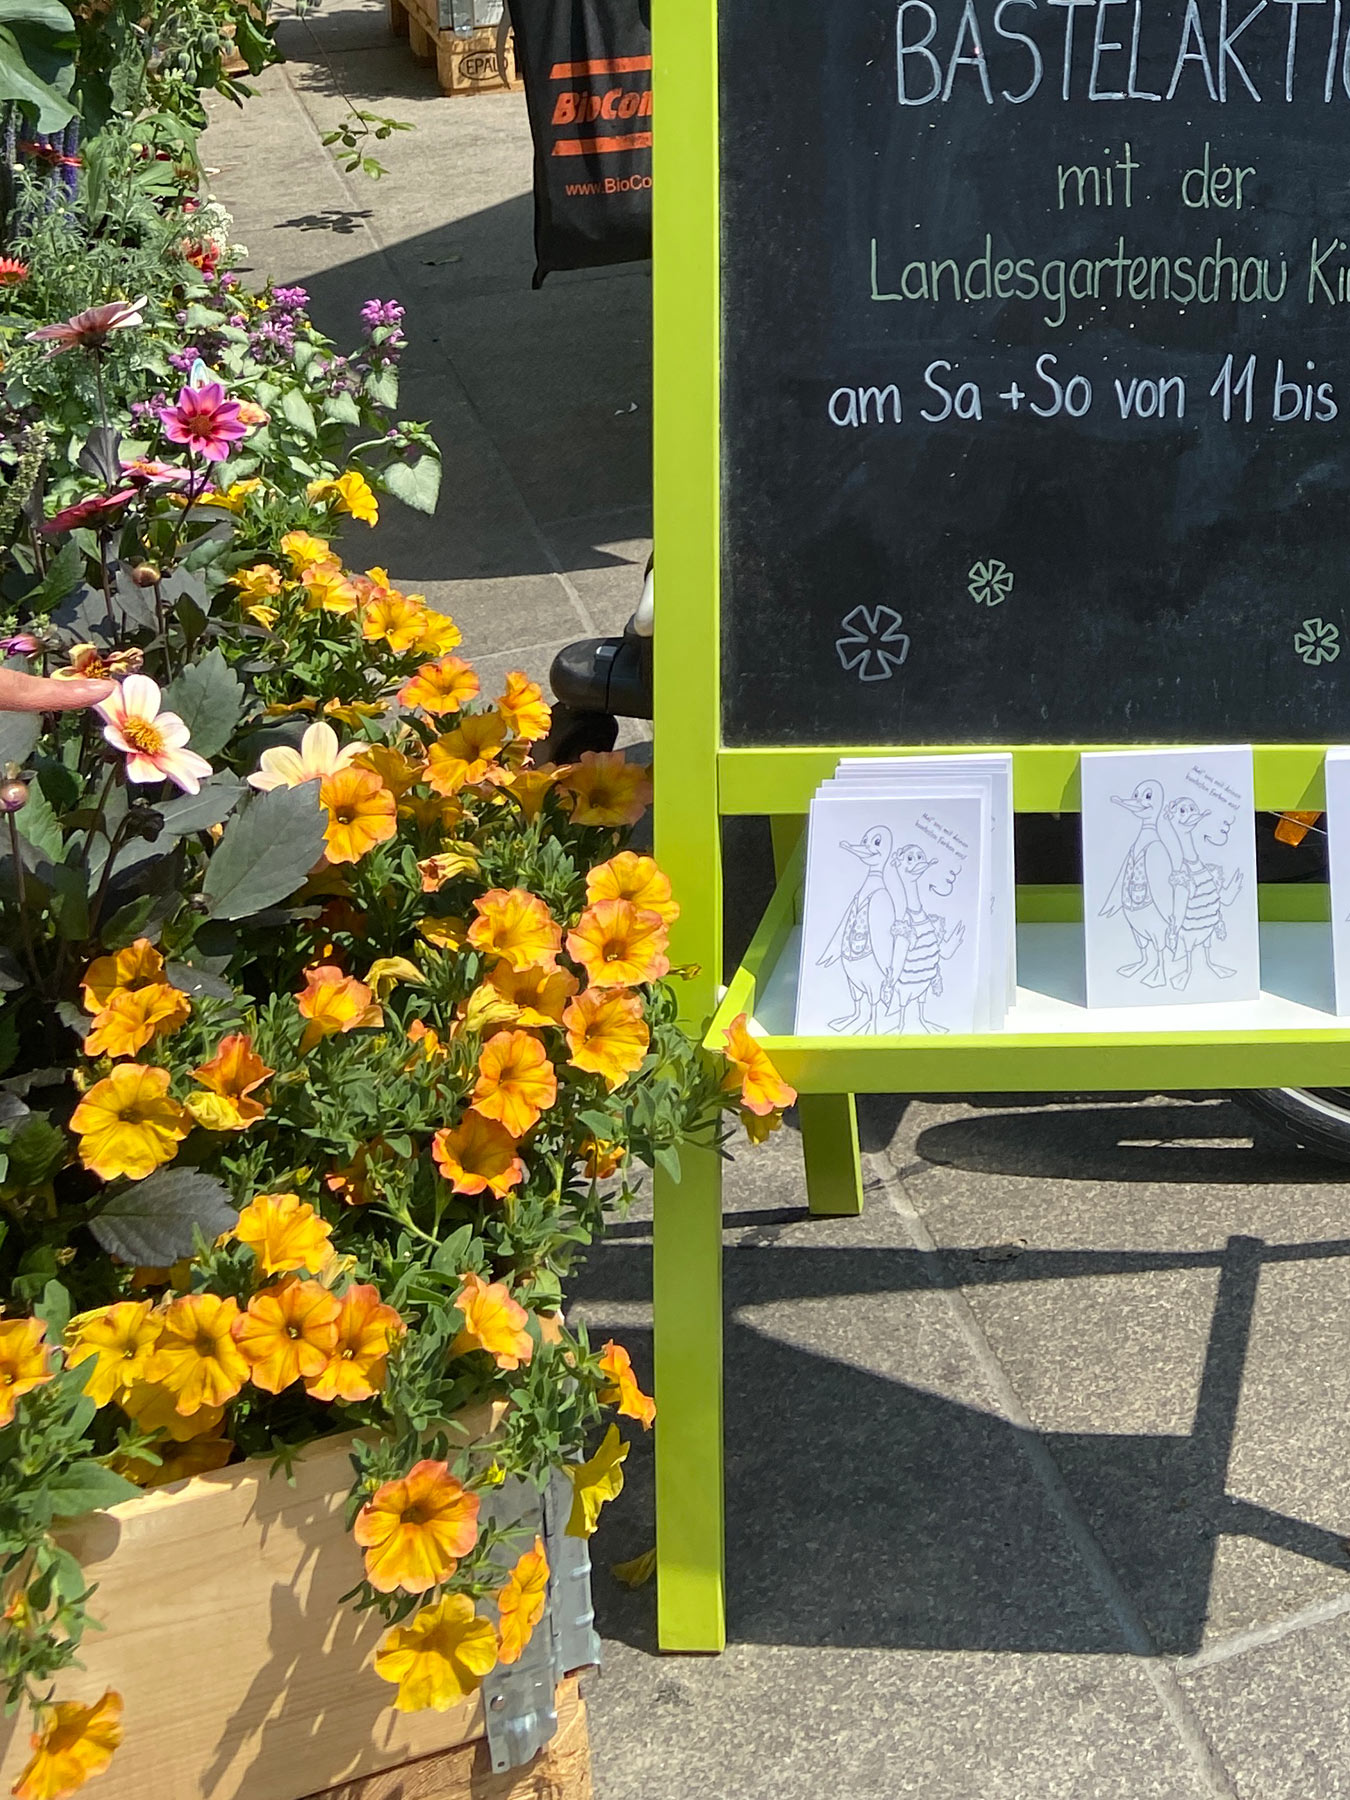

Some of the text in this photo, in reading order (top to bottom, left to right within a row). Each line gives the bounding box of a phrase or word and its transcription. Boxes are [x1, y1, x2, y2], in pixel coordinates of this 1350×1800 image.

[565, 173, 652, 196] www.BioCo
[1057, 141, 1257, 210] mit der
[870, 232, 1287, 328] Landesgartenschau
[827, 380, 902, 428] am
[919, 359, 983, 423] Sa
[1113, 375, 1186, 420] von
[1209, 353, 1256, 422] 11
[1272, 358, 1338, 422] bis
